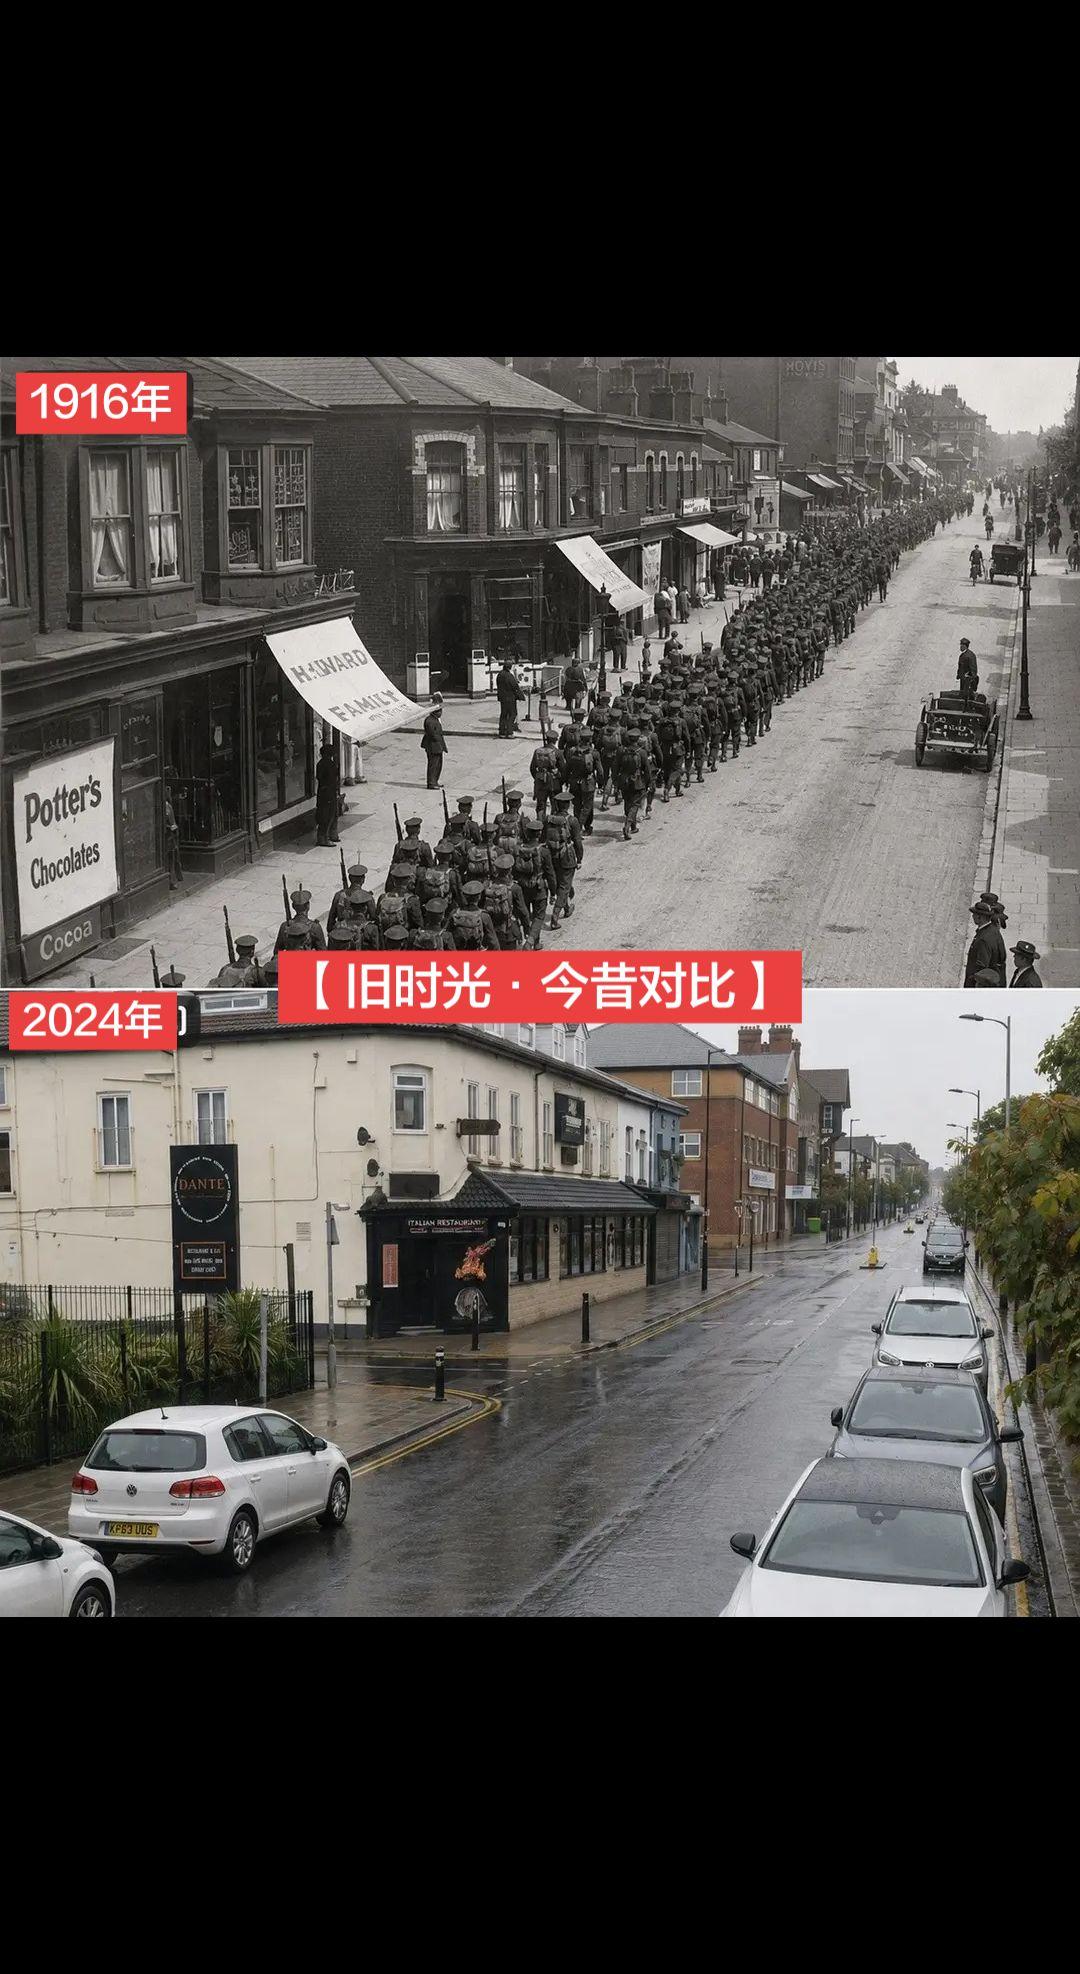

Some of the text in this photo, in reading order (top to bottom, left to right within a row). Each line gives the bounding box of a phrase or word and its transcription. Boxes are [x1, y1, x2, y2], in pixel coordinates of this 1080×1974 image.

[24, 774, 101, 843] Potter's
[31, 842, 100, 889] Chocolates
[40, 920, 93, 960] Cocoa
[179, 1179, 225, 1190] DANTE
[408, 1219, 435, 1227] ITALIAN
